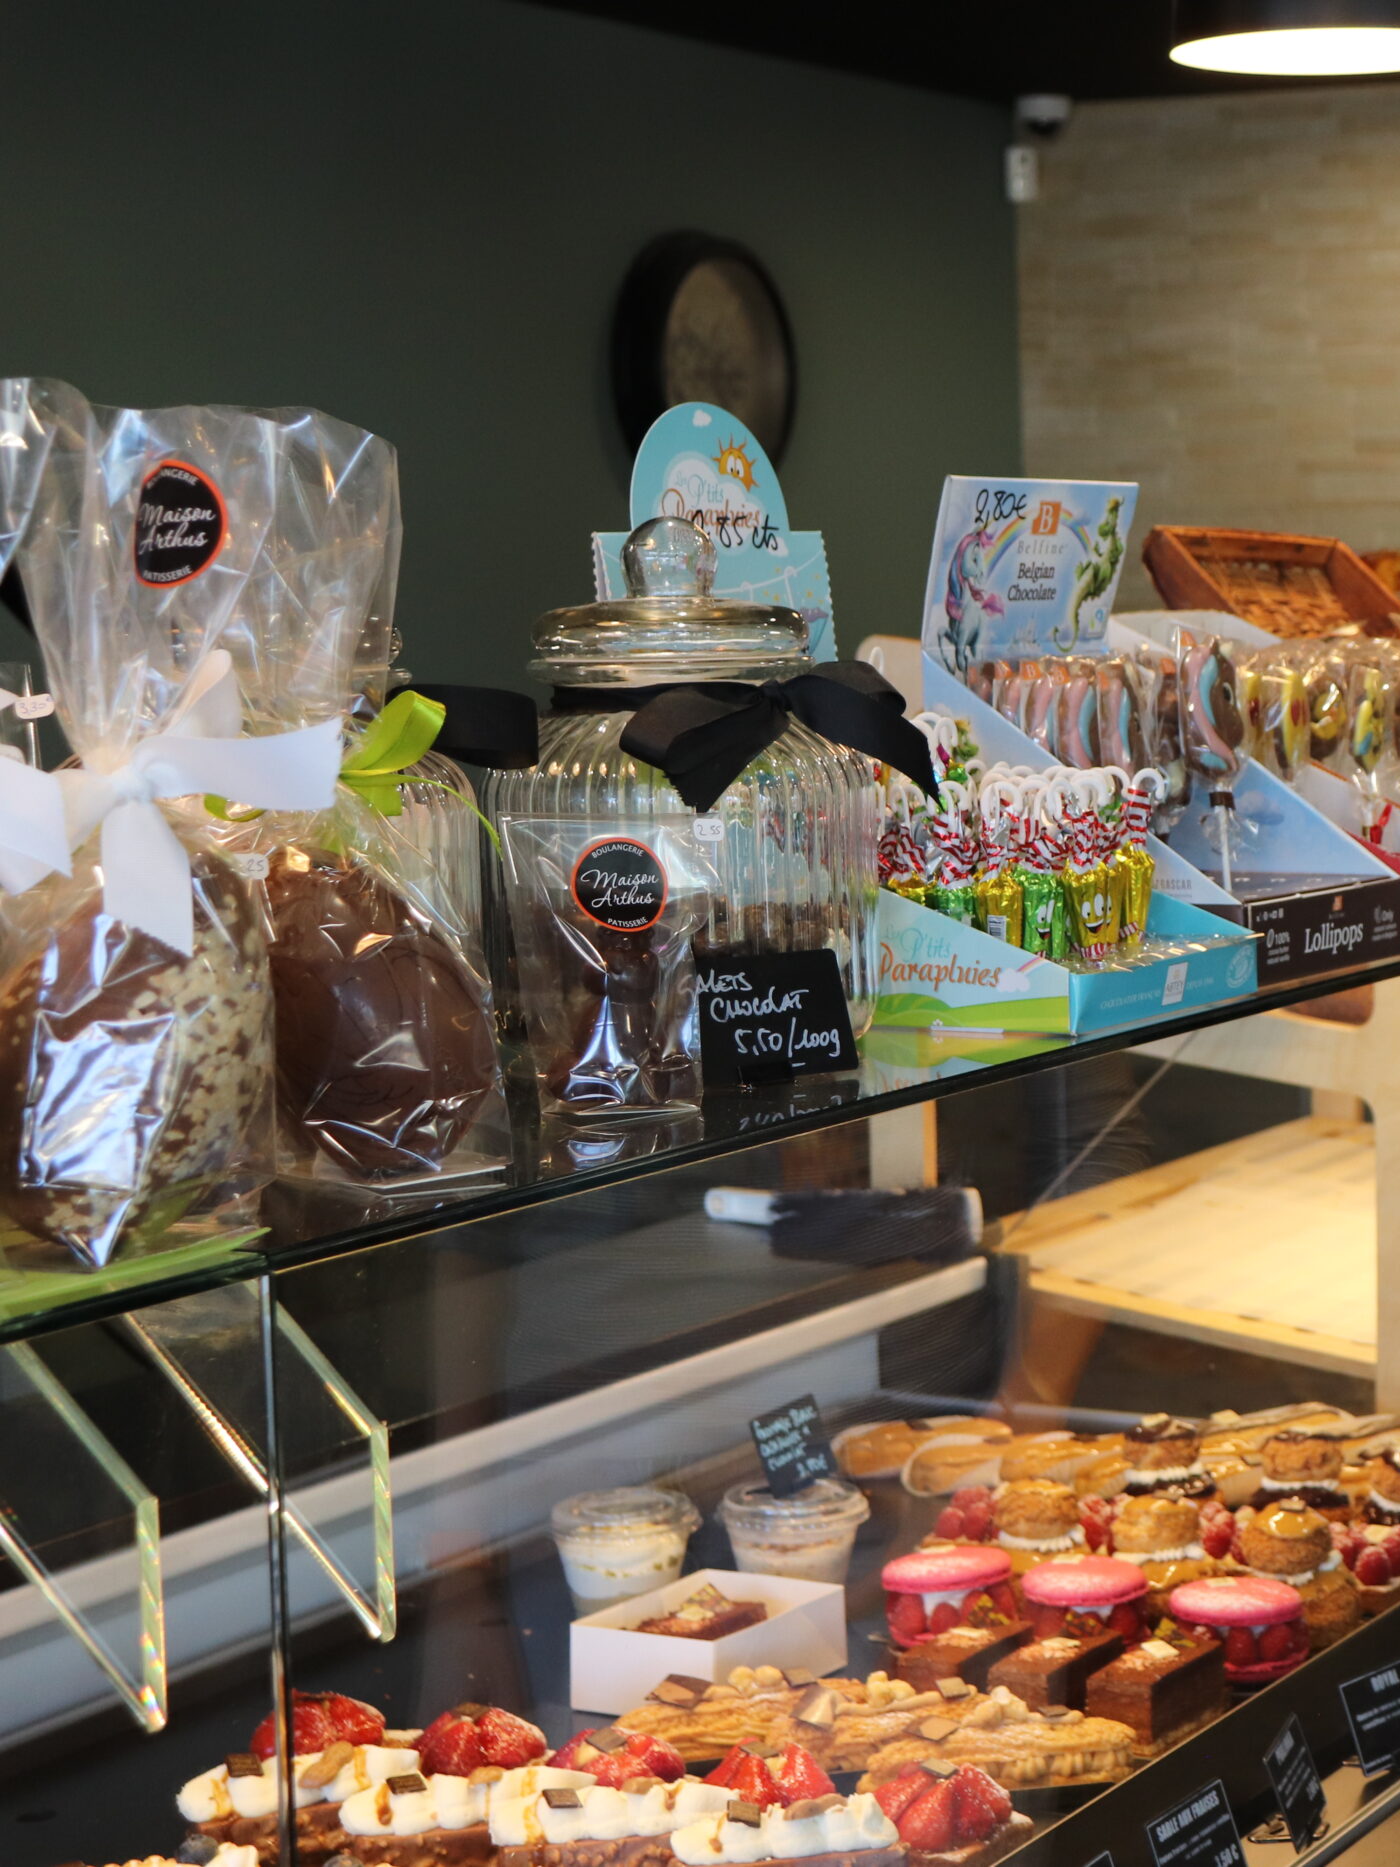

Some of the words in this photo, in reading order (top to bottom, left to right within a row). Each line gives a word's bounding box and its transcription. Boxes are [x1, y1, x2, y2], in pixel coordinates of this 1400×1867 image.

[139, 503, 216, 528] Maison
[139, 521, 208, 555] Arthus
[1017, 539, 1064, 555] Belfine
[1018, 562, 1055, 583] Belgian
[1007, 584, 1057, 601] Chocolate
[591, 843, 646, 859] BOULANGERIE
[580, 869, 659, 889] Maison
[591, 886, 655, 908] Arthus
[607, 916, 648, 928] PATISSERIE
[900, 927, 950, 962] P'tits
[1304, 923, 1364, 954] Lollipops
[879, 941, 1003, 992] Parapluies
[1370, 1668, 1400, 1692] ROYAL
[1177, 1807, 1194, 1829] AUX
[1190, 1790, 1220, 1820] FRAISES
